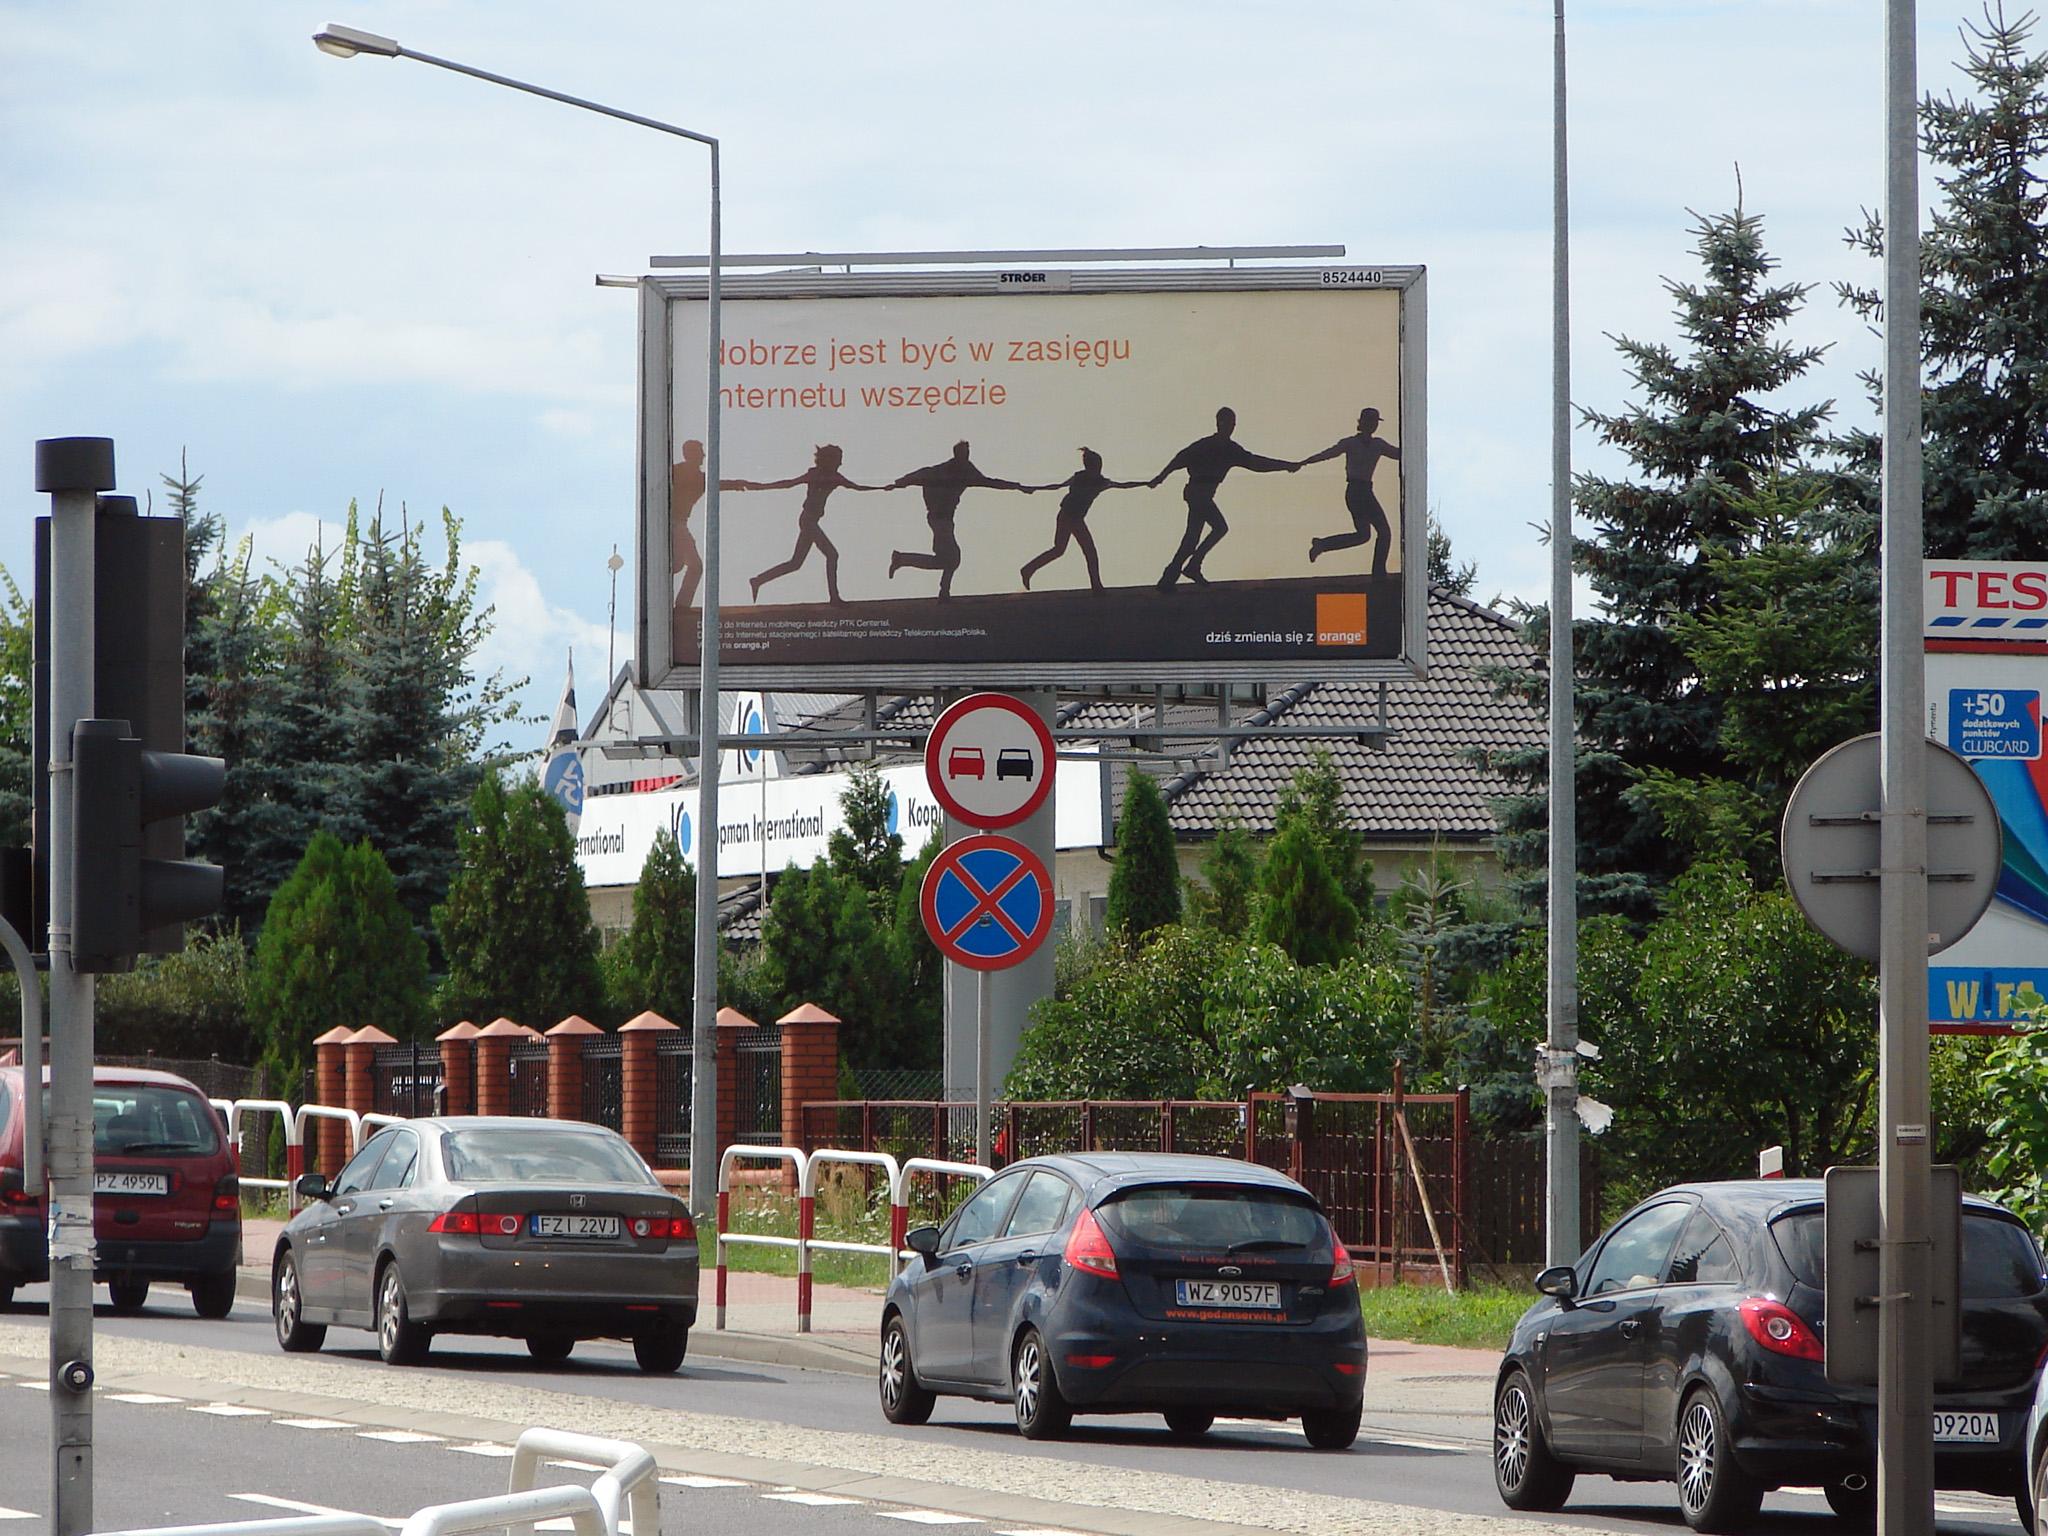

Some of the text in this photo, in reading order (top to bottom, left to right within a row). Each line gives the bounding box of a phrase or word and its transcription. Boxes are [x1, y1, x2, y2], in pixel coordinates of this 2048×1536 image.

[1322, 271, 1381, 283] 8524440
[828, 338, 887, 371] jest
[901, 336, 957, 370] być
[968, 341, 994, 362] w
[1007, 334, 1131, 368] zasięgu
[719, 378, 1007, 413] nternetu wszędzie
[1205, 631, 1362, 645] dziś zmienia się z orange
[1962, 693, 2006, 716] +50
[1962, 719, 2020, 730] dodatkowych
[1962, 729, 2001, 739] punktów
[1962, 740, 2030, 754] CLUBCARD
[908, 797, 943, 834] Koop
[719, 804, 824, 854] pman Inernational
[576, 823, 625, 856] rnational
[96, 1175, 164, 1191] PZ 4959L
[541, 1217, 619, 1233] FZI 22VJ
[1188, 1283, 1275, 1303] WZ 9057F
